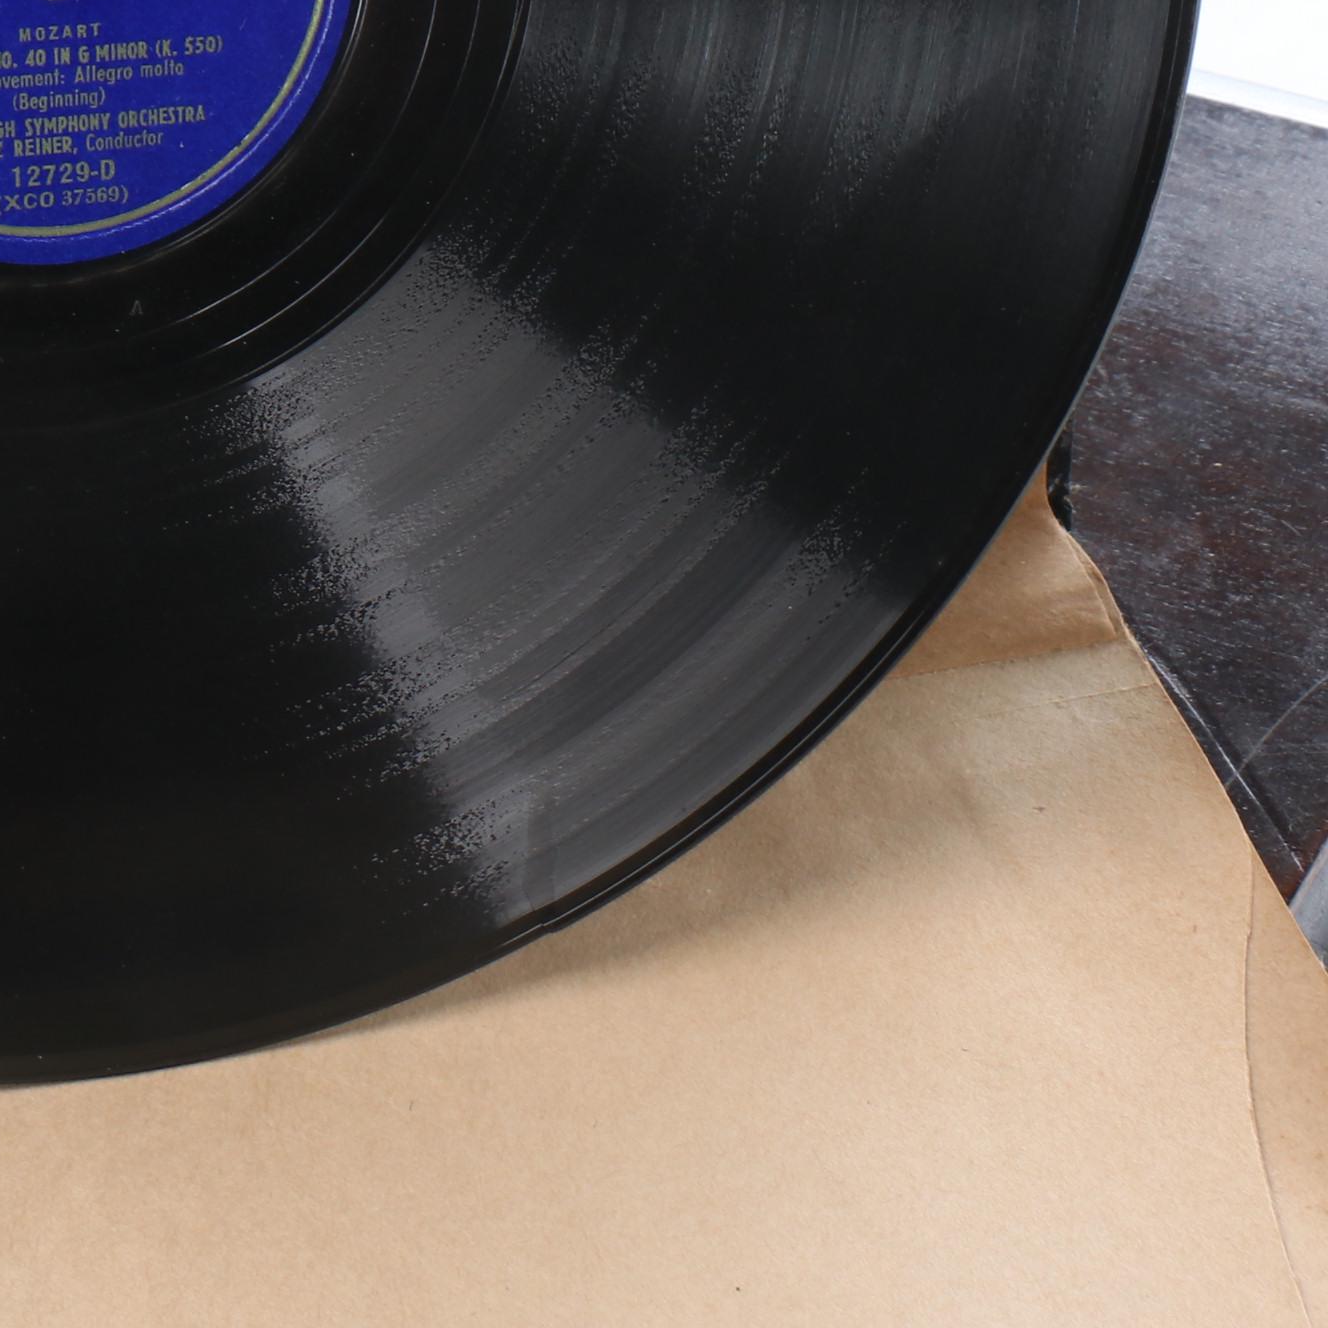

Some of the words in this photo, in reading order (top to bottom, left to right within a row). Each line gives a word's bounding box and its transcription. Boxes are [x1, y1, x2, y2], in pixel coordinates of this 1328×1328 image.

[18, 22, 103, 43] MOZART
[25, 47, 46, 67] 40
[53, 46, 71, 65] IN
[78, 45, 90, 64] G
[95, 40, 149, 62] MINOR
[155, 38, 178, 59] (K.
[184, 35, 223, 55] 550)
[74, 64, 133, 85] Allegro
[141, 60, 184, 78] molto
[13, 90, 106, 111] (Beginning)
[24, 113, 112, 136] SYMPHONY
[118, 104, 206, 128] ORCHESTRA
[14, 137, 78, 157] REINER,
[85, 131, 164, 152] Conductor
[11, 159, 116, 188] 12729-D
[61, 186, 130, 207] 37569)
